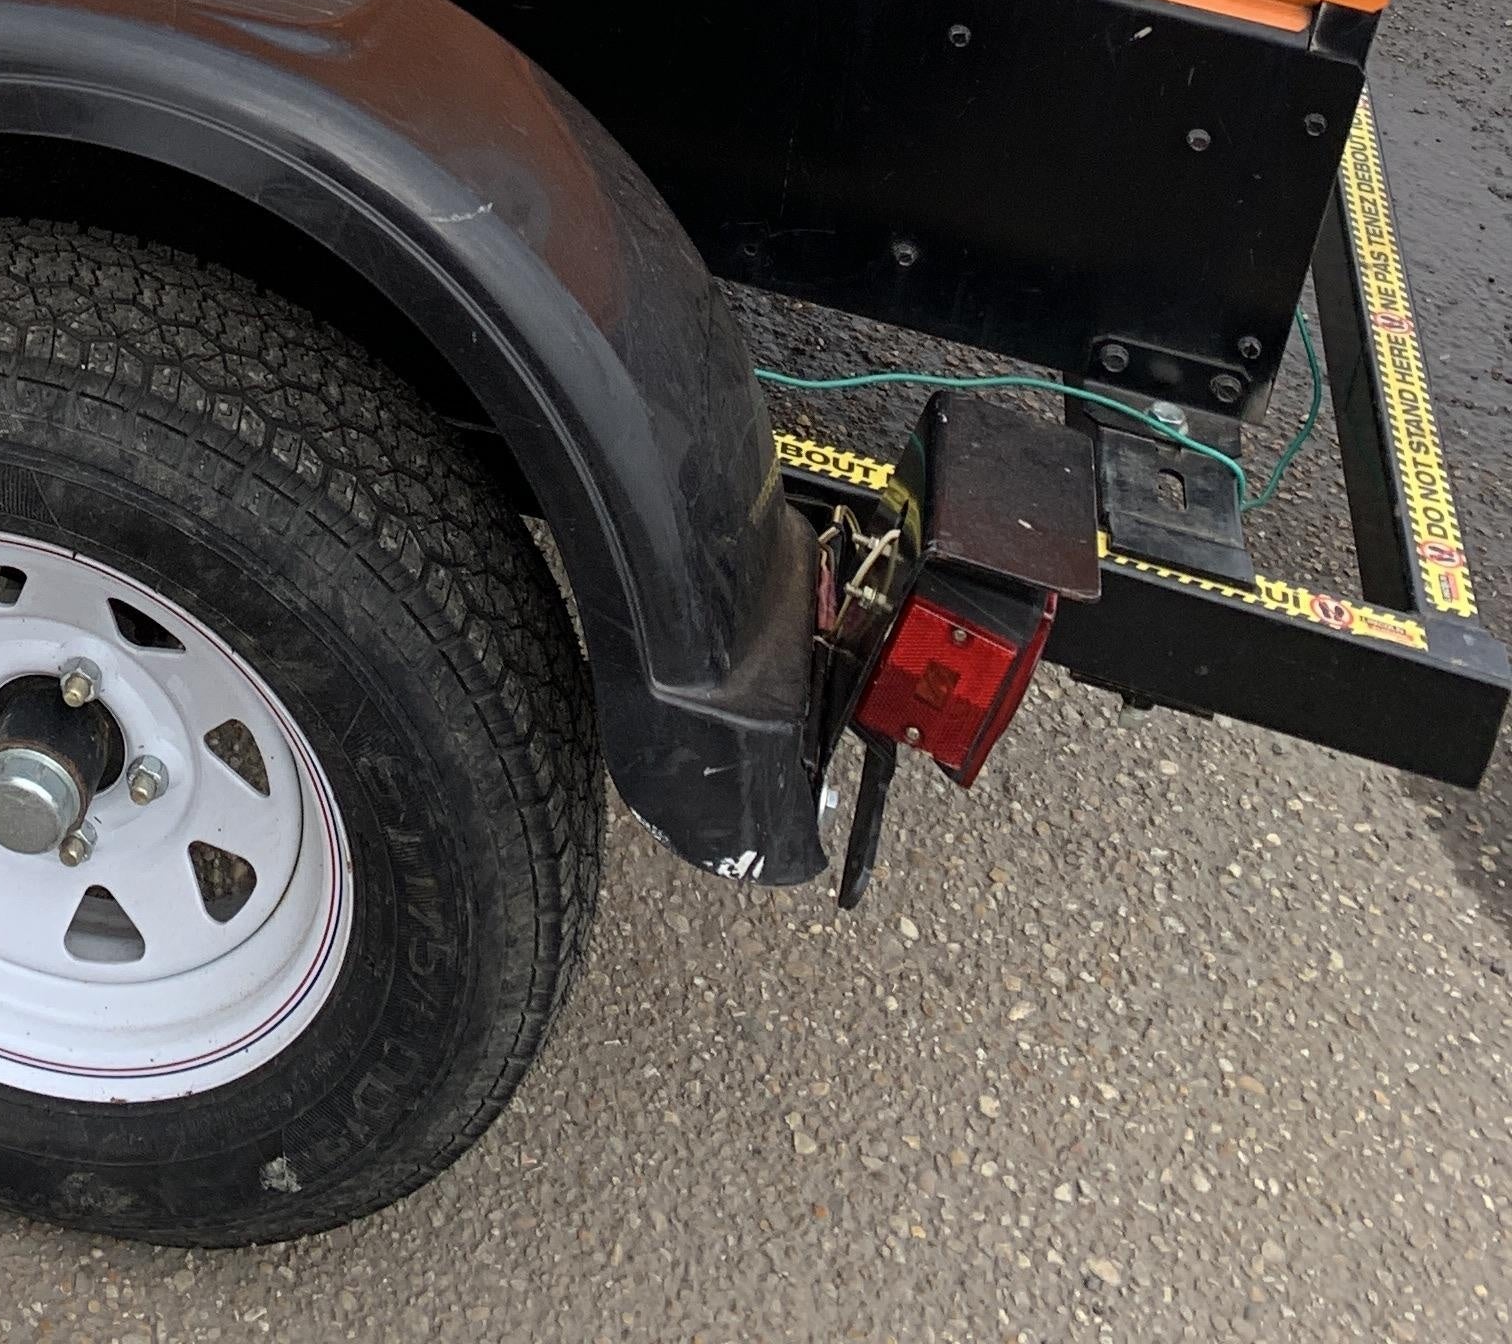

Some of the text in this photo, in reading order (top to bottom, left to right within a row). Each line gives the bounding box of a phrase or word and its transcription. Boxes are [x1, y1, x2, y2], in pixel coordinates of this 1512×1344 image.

[1349, 135, 1377, 194] DEBOUT
[1359, 195, 1387, 246] TENEZ
[1369, 250, 1394, 285] PAS
[1377, 284, 1400, 312] NE
[1387, 333, 1448, 541] DO NOT STAND HERE
[781, 443, 878, 479] BOUT
